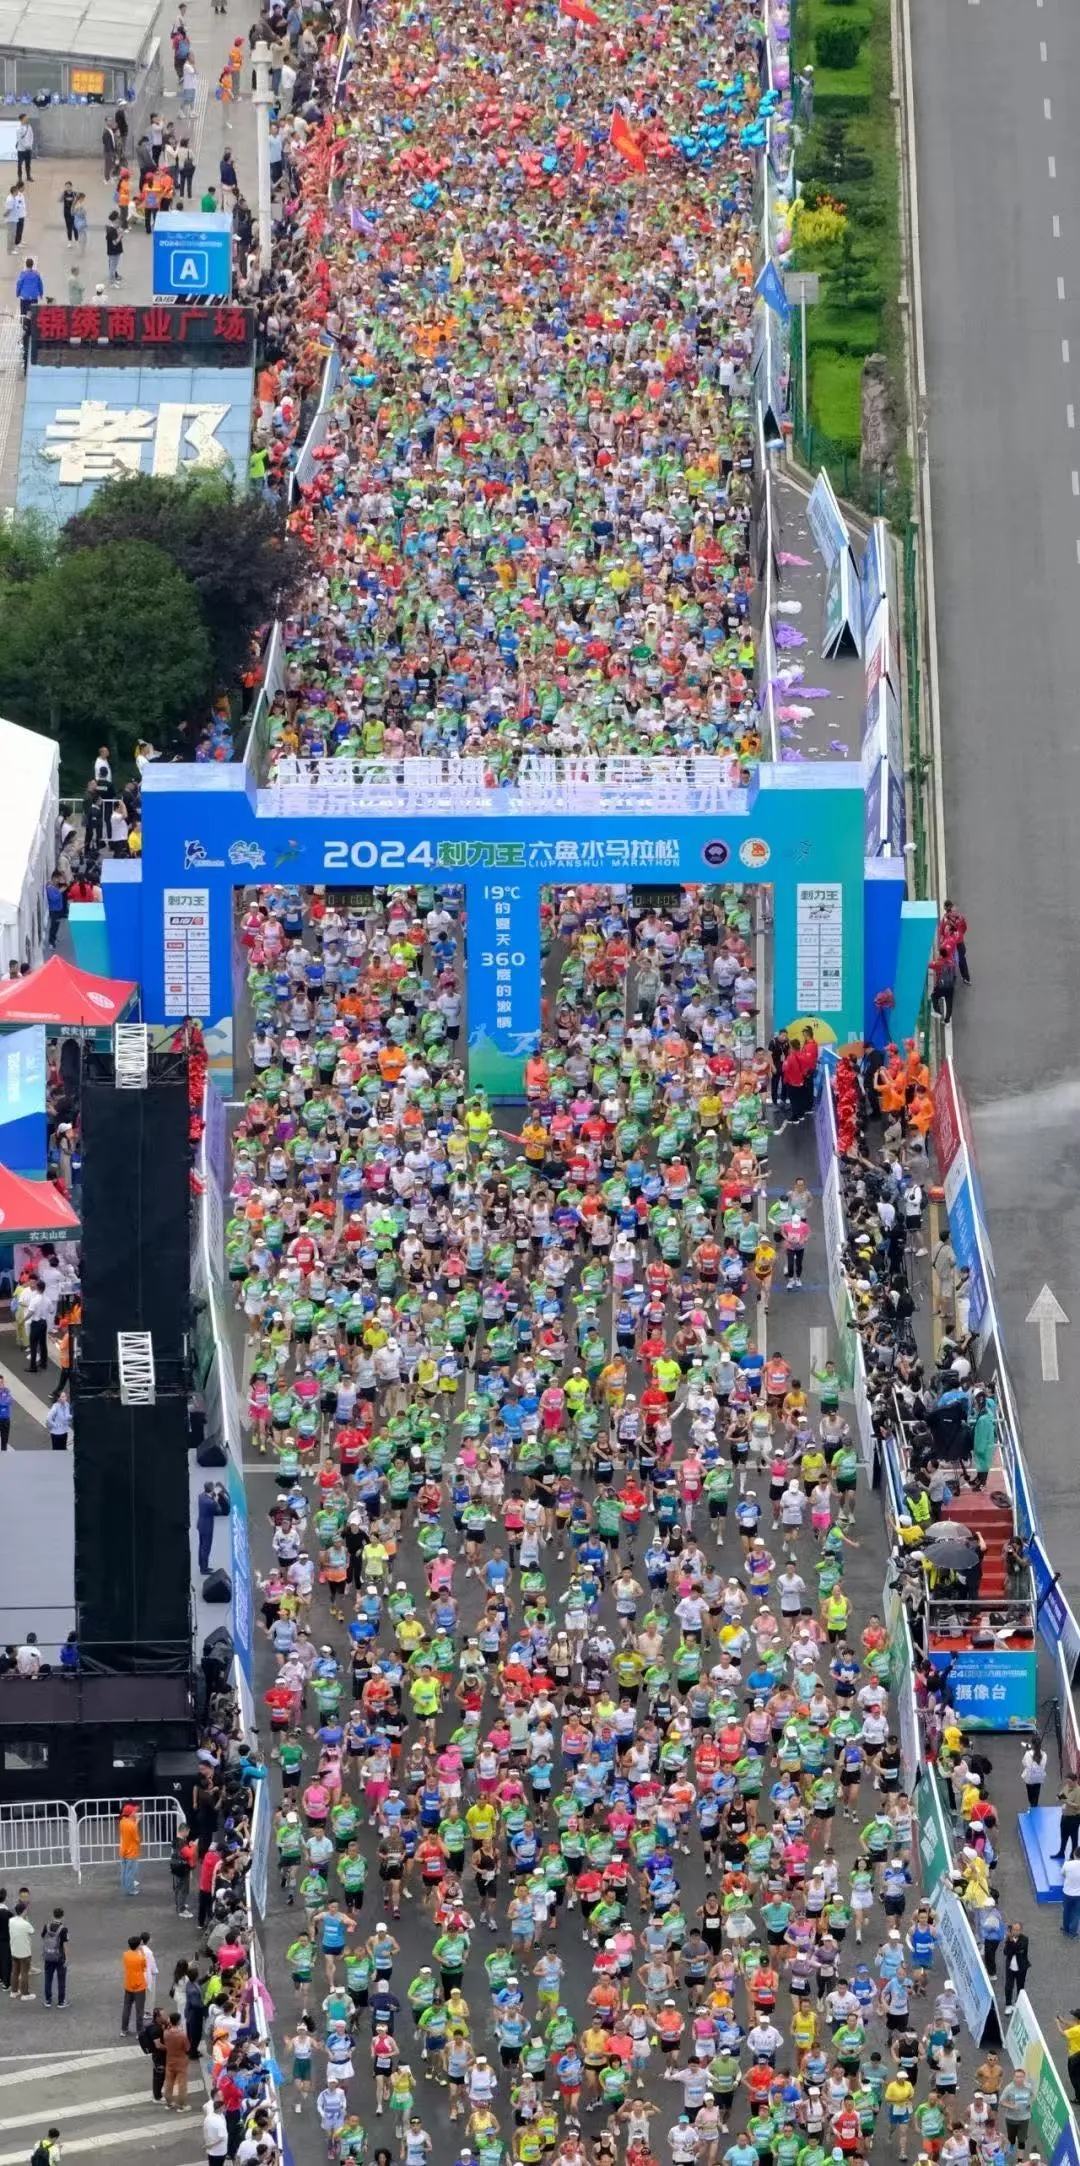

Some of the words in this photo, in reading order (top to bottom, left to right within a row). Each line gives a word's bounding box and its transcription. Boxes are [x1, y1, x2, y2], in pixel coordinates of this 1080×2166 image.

[179, 258, 200, 280] A
[36, 307, 247, 342] 锦绣商业广场
[38, 400, 232, 486] 都
[323, 840, 433, 869] 2024
[436, 840, 526, 869] 刺力王
[528, 839, 681, 860] 六盘水马拉松
[528, 859, 604, 869] LIUPANSHUI
[611, 858, 681, 868] MARATHON
[955, 1683, 1008, 1701] 摄像台
